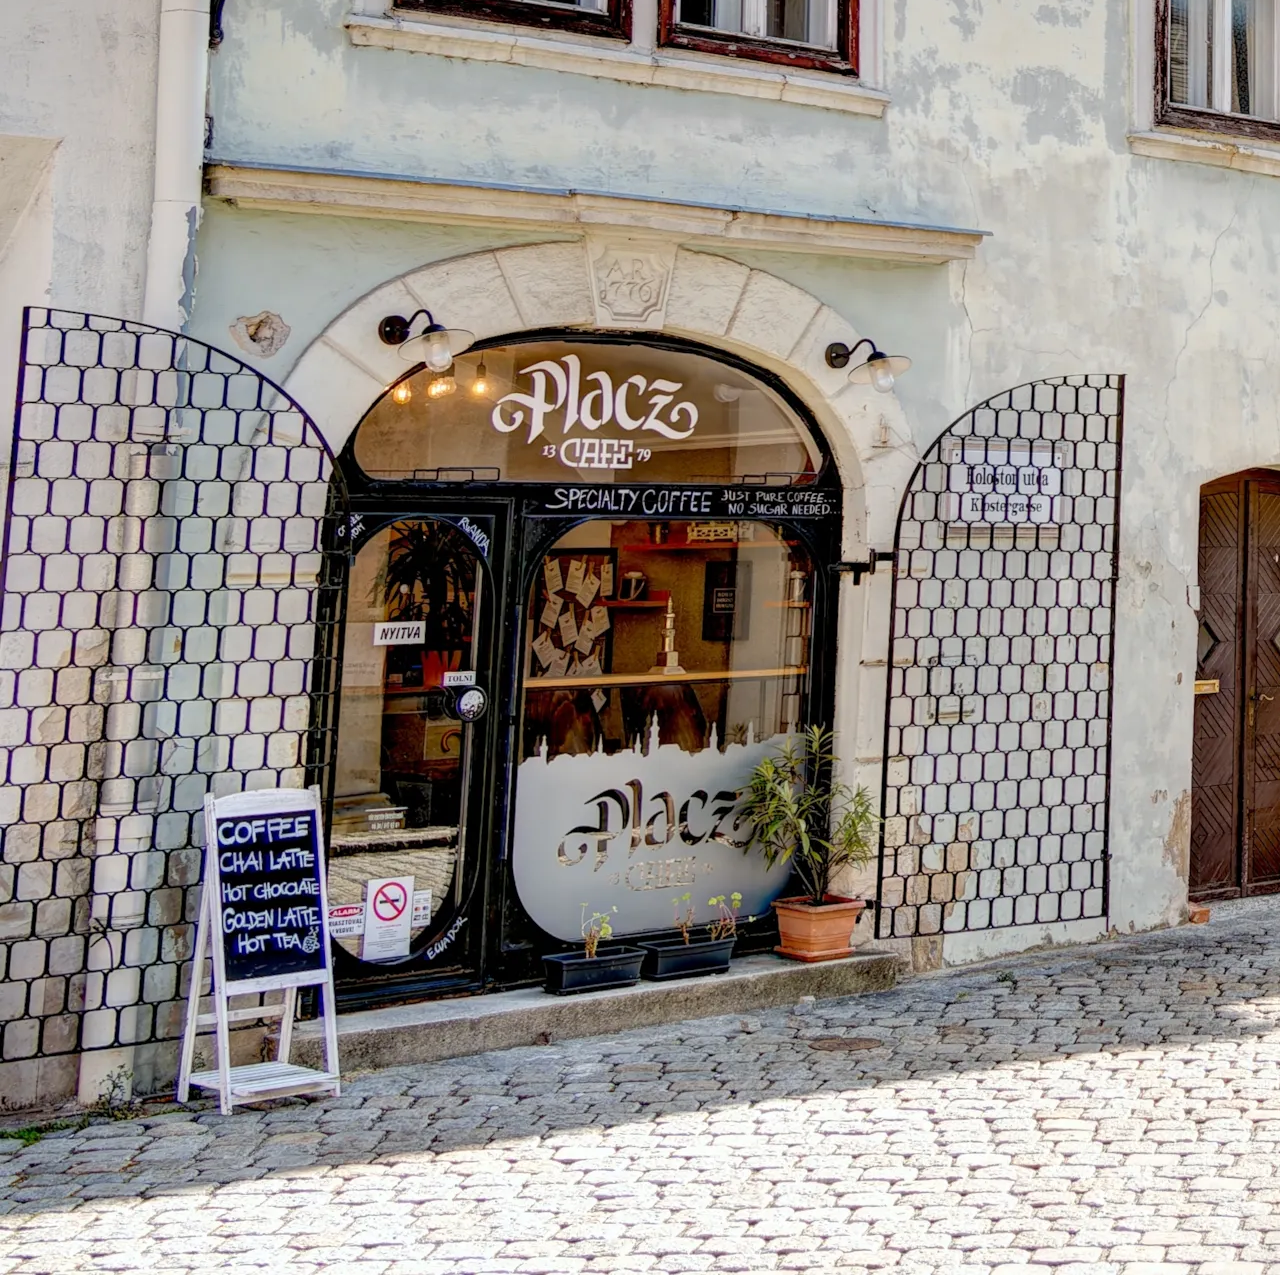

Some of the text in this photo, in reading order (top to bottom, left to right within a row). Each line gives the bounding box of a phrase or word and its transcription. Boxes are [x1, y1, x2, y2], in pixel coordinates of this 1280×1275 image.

[492, 354, 699, 444] Placz
[542, 444, 556, 459] 13
[636, 448, 651, 463] 79
[1023, 467, 1049, 486] uta
[545, 488, 713, 514] SPECIALTY COFFEE
[720, 490, 751, 502] JUST
[755, 492, 786, 503] PURE
[970, 497, 1043, 516] Kostegasse
[728, 503, 745, 515] NO
[748, 503, 789, 515] SUGAR
[458, 517, 490, 557] RWANDA
[380, 626, 421, 640] NYITVA
[447, 674, 473, 683] TOLNI
[218, 815, 312, 846] COFFEE
[219, 848, 315, 874] CHAI LATTE
[222, 878, 321, 904] HOT CHOCOLATE
[223, 905, 322, 934] GOLDEN LATTE
[332, 907, 361, 917] ALARM
[237, 932, 303, 955] HOT TEA
[426, 916, 469, 961] ECUADOR
